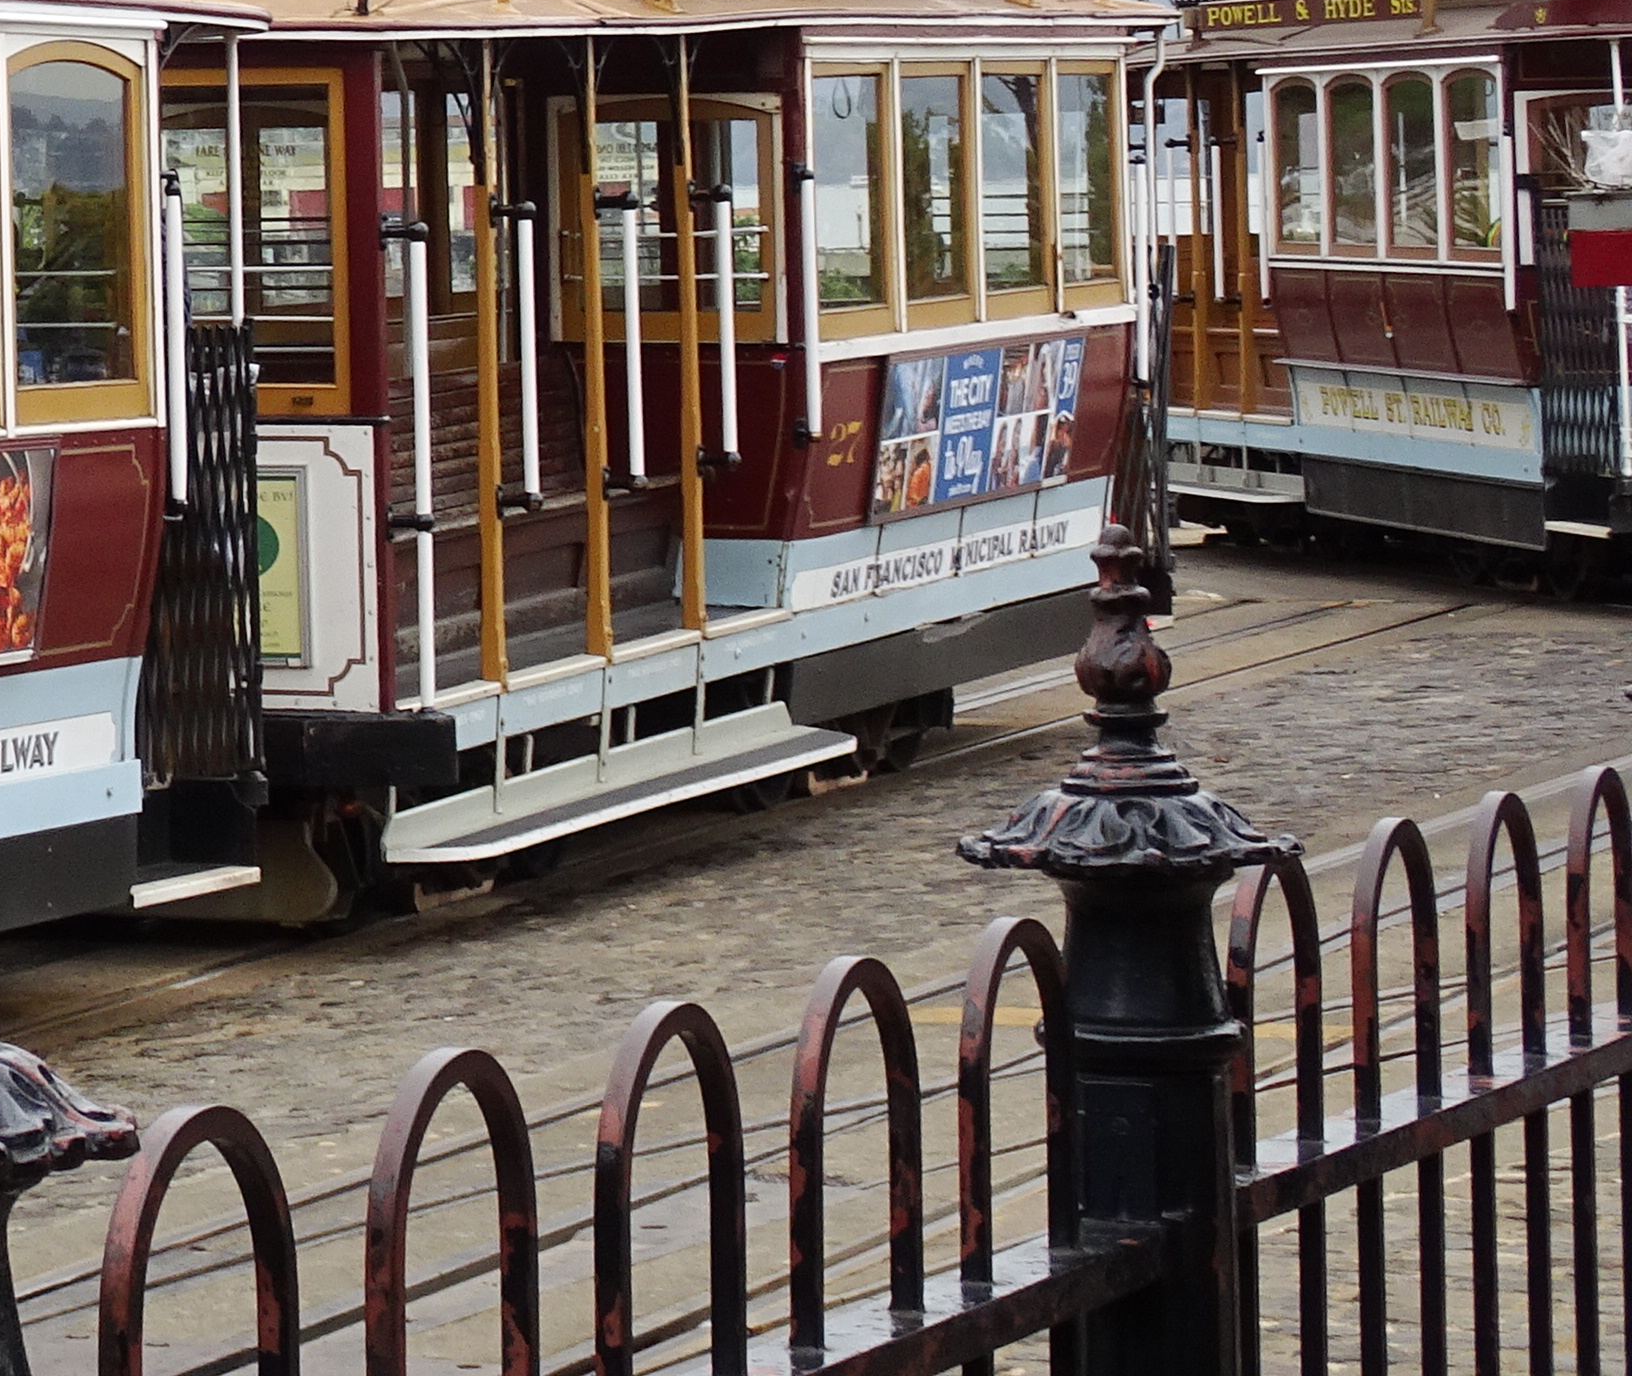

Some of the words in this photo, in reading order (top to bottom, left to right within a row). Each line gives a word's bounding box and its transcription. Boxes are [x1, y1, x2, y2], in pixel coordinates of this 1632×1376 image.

[1207, 3, 1282, 26] POWELL
[1295, 0, 1310, 20] &
[1319, 385, 1379, 421] POWELL
[1409, 394, 1474, 432] RAILWAY
[830, 564, 860, 599] SAN
[864, 549, 944, 595] FRANCISCO
[1018, 521, 1070, 552] RAILWAY
